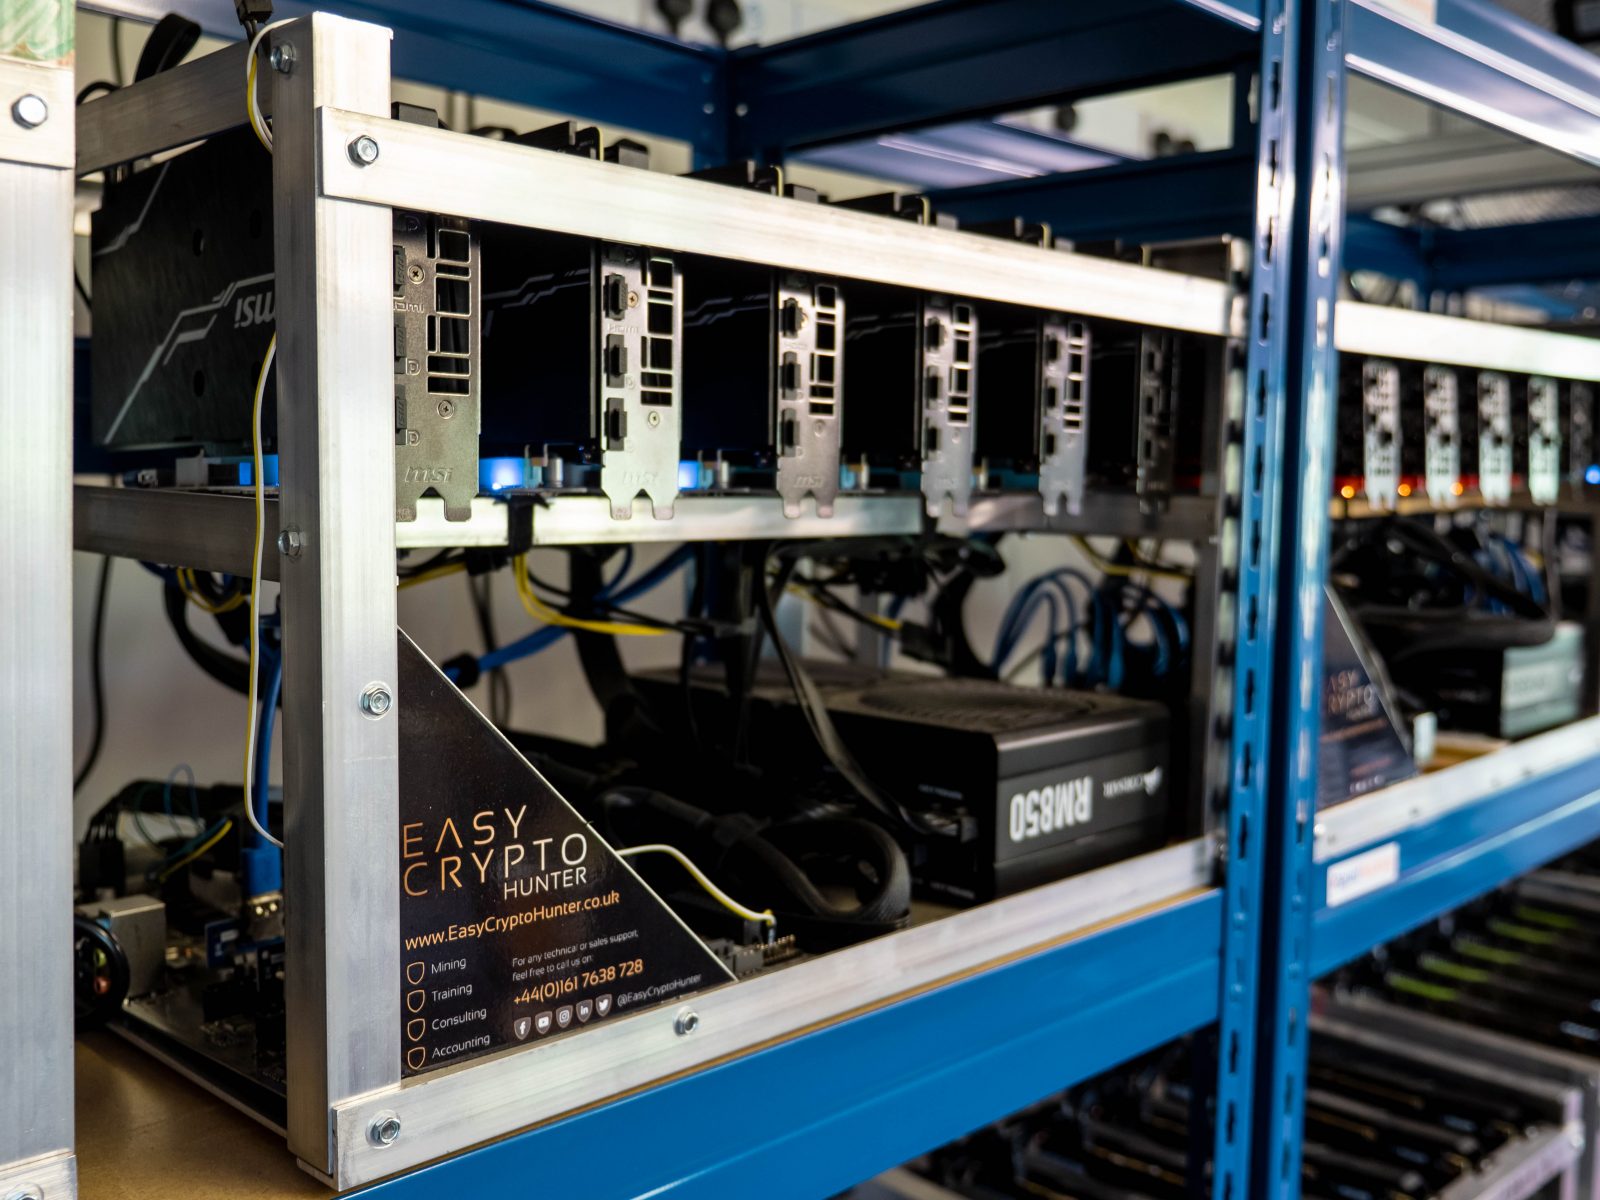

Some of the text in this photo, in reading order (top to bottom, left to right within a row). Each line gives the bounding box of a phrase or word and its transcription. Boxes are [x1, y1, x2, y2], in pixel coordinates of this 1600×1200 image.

[404, 466, 454, 483] msi
[1009, 775, 1094, 842] RM850
[402, 804, 527, 859] EASY
[403, 832, 588, 897] CRYPTO
[503, 866, 588, 901] HUNTER
[405, 890, 620, 951] www.EasyCryptoHunter.co.uk
[431, 958, 467, 975] Mining
[512, 957, 526, 968] For
[527, 953, 543, 964] any
[544, 944, 577, 960] technical
[579, 941, 587, 951] or
[589, 937, 609, 949] sales
[512, 970, 528, 982] feel
[529, 967, 545, 977] free
[546, 963, 555, 973] to
[556, 959, 570, 970] call
[571, 957, 580, 968] us
[513, 958, 645, 1006] +44(0)161 7638 728
[431, 984, 473, 1002] Training
[617, 973, 702, 1008] @EasyCryptoHunter
[431, 1008, 488, 1030] Consulting
[431, 1034, 491, 1059] Accounting
